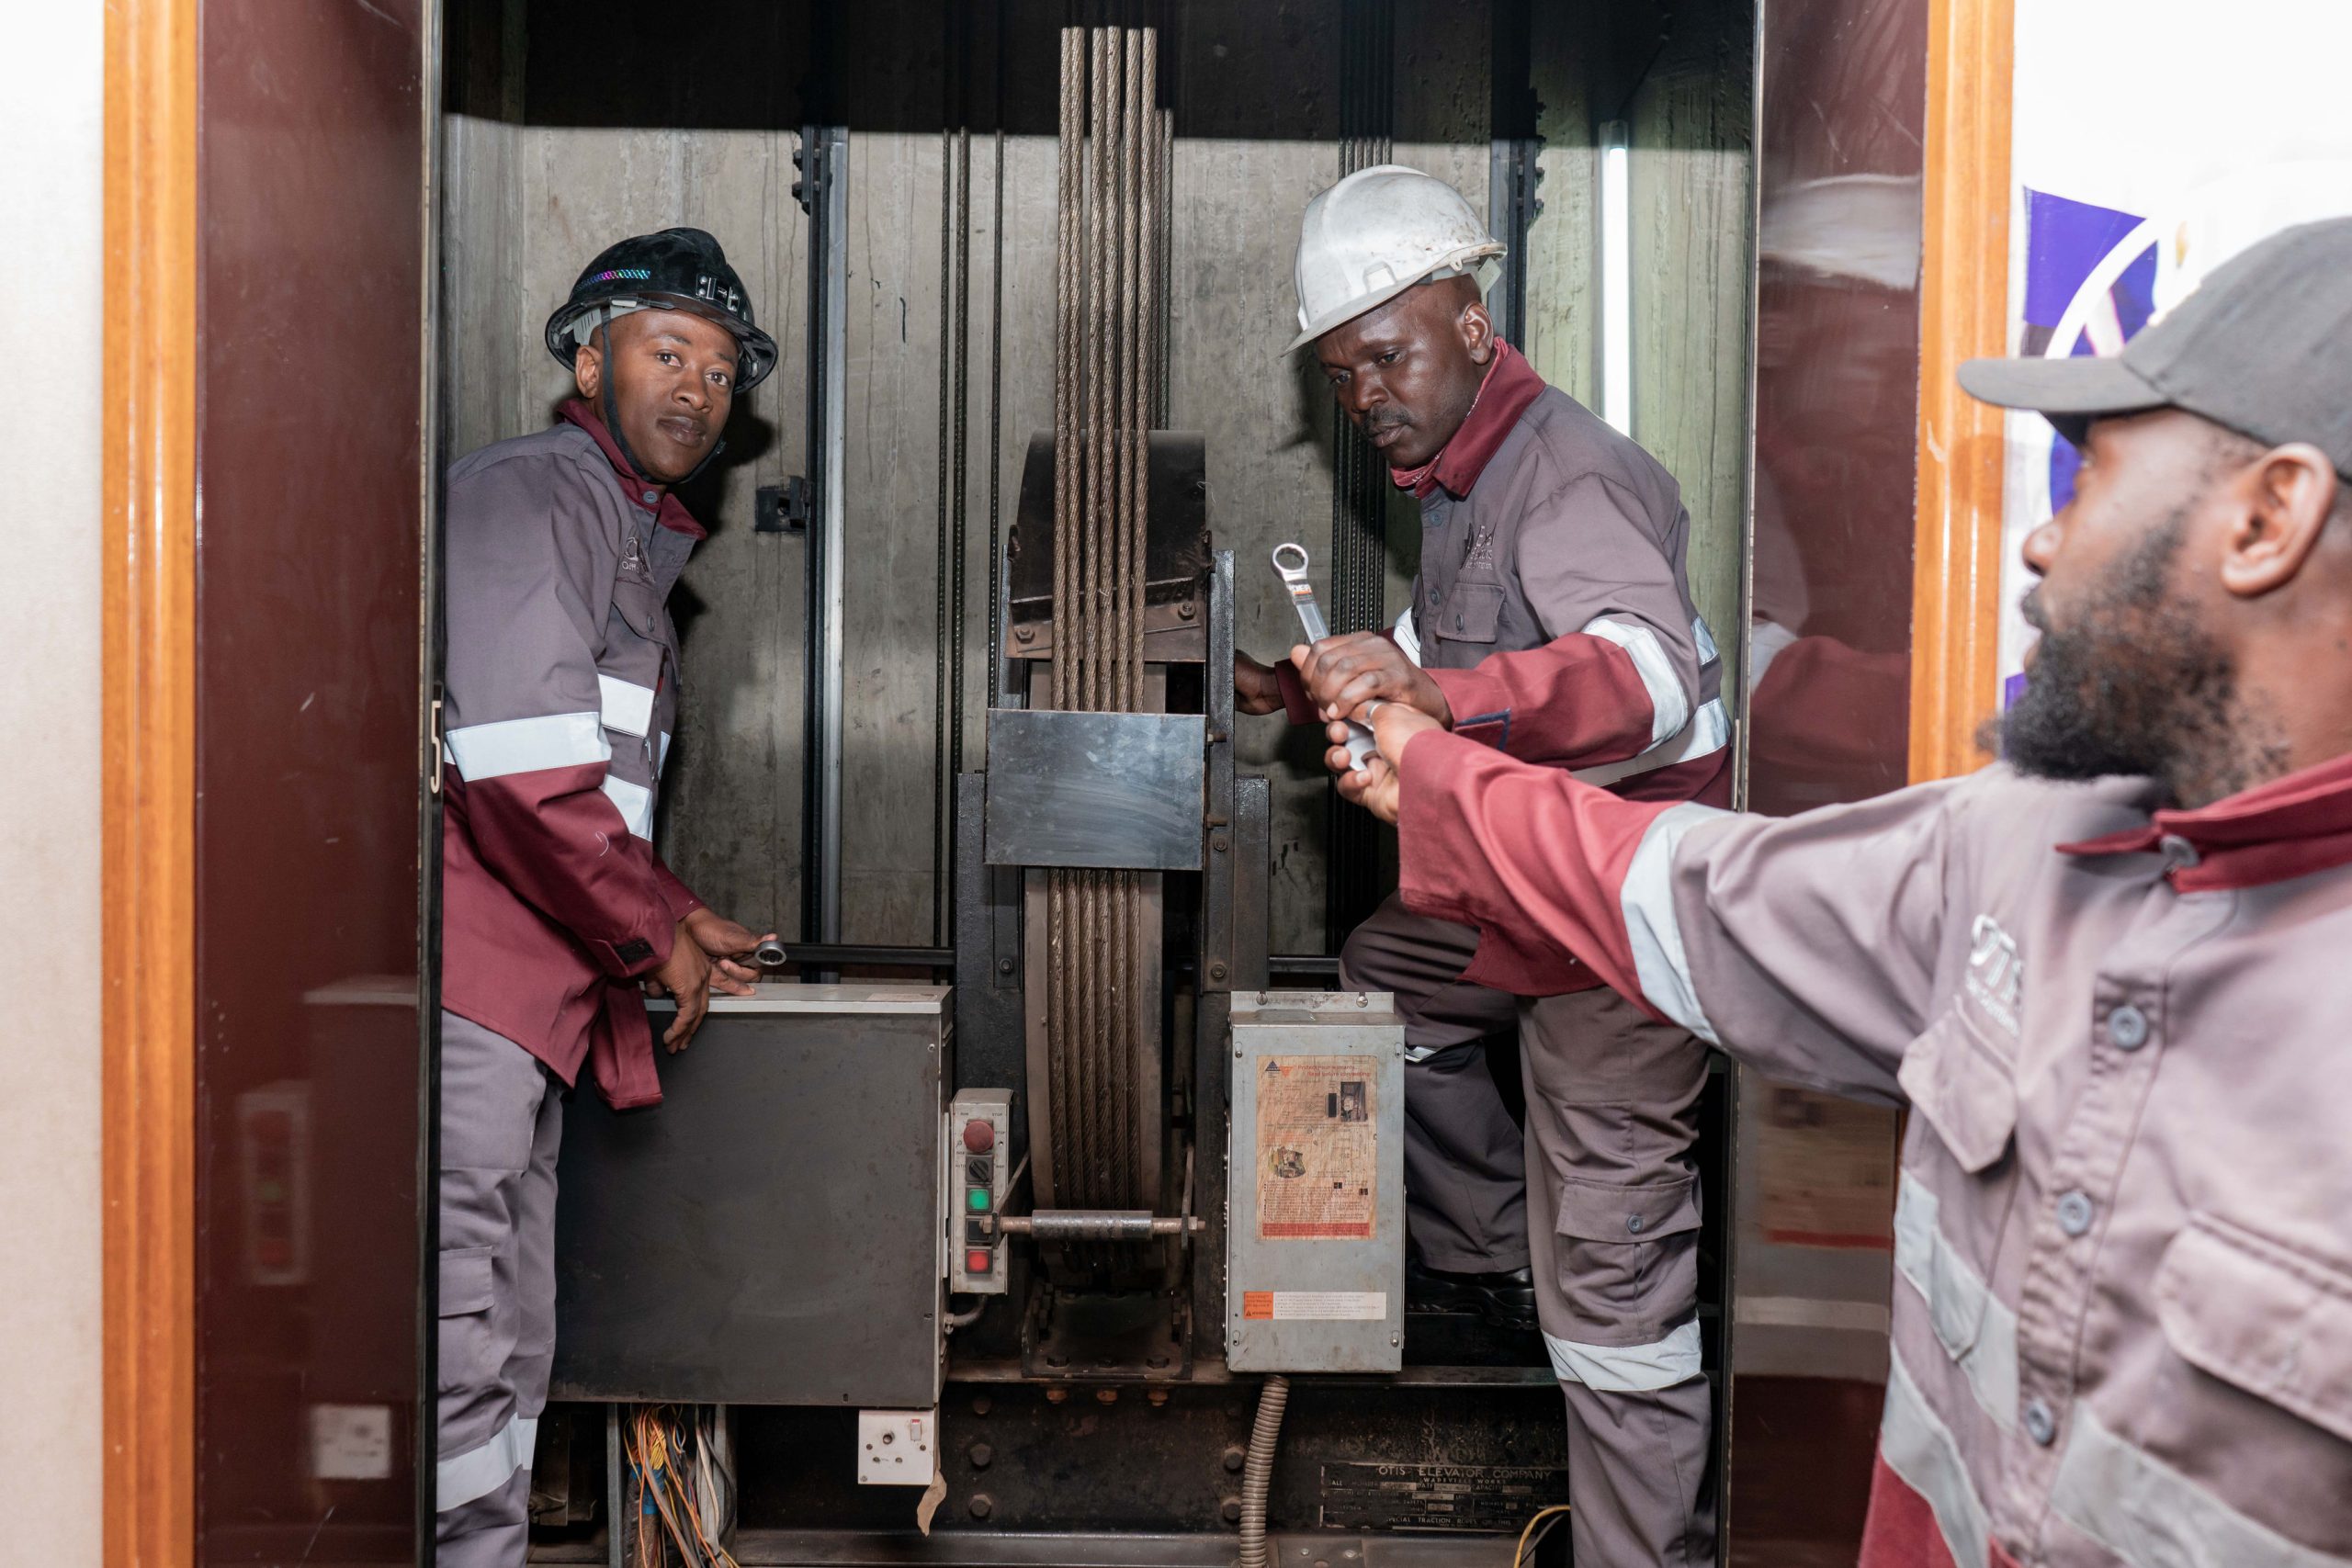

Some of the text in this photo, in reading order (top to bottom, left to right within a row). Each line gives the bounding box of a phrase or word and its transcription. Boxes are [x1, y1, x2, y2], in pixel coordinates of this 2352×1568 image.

[1378, 1466, 1552, 1480] OTIS ELEVATOR COMPANY
